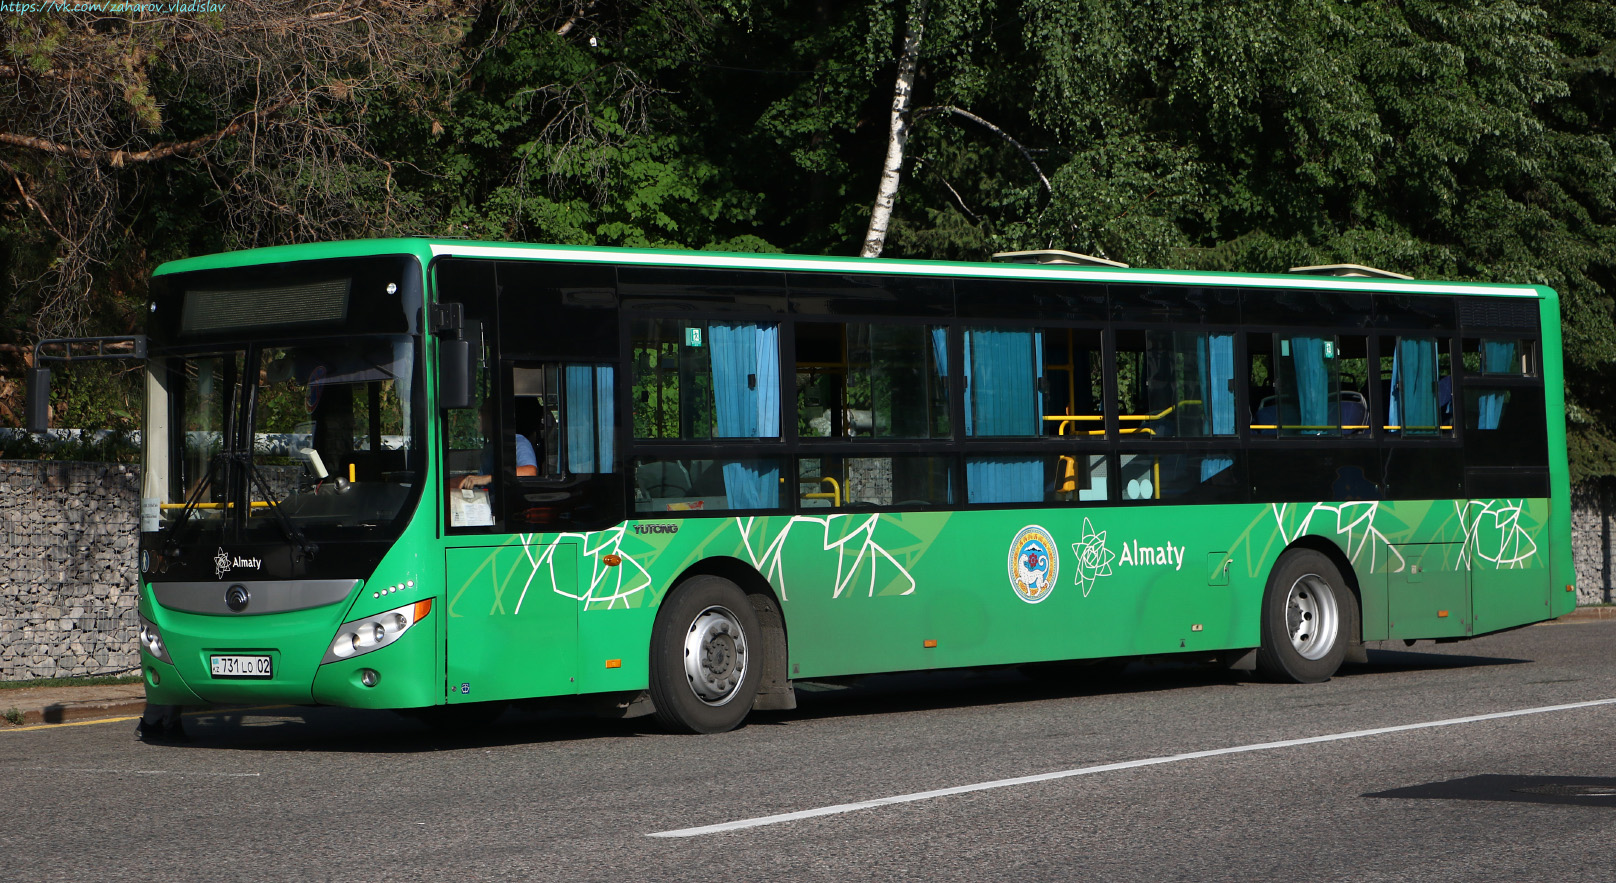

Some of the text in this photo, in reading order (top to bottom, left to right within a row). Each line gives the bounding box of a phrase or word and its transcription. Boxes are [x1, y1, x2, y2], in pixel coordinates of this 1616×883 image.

[633, 523, 679, 535] YUTONG
[232, 555, 262, 571] Almaty
[1118, 539, 1186, 571] Almaty
[221, 658, 270, 674] 731 LO 02
